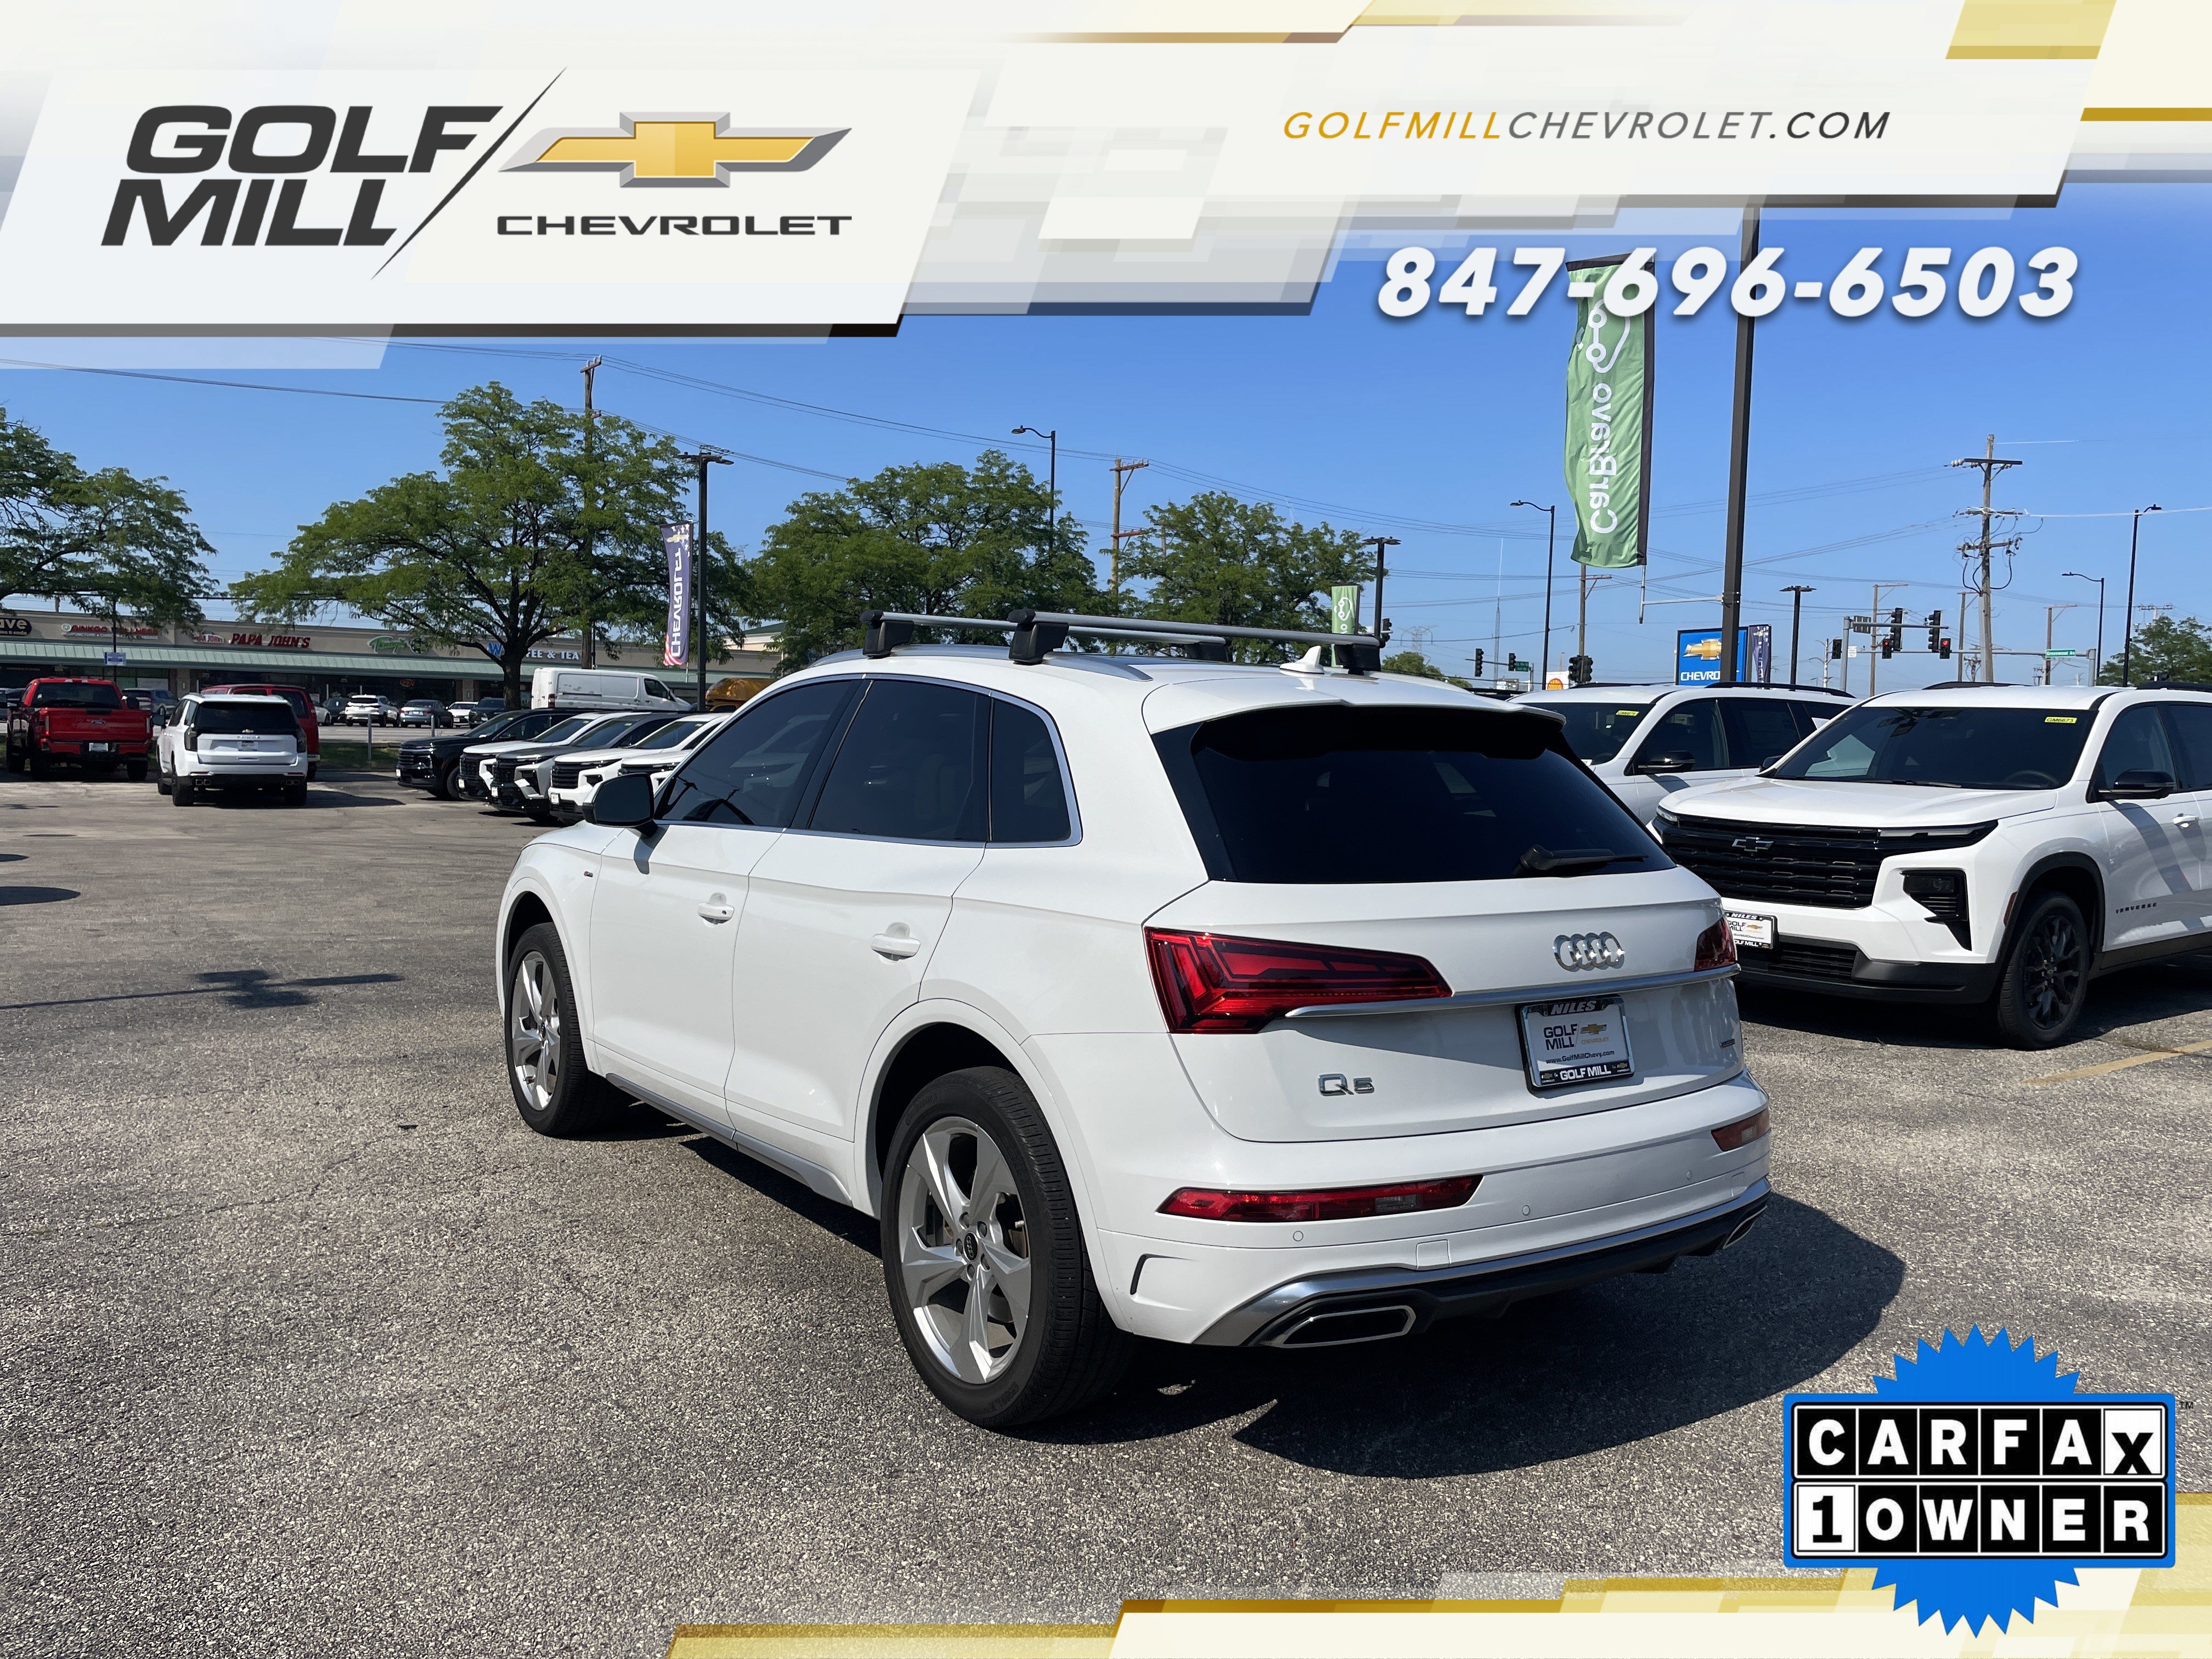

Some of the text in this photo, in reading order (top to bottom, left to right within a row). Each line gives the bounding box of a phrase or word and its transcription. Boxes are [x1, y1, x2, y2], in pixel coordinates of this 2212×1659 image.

[230, 633, 311, 648] PAPA JOHN'S
[560, 651, 579, 659] TEA
[1680, 671, 1720, 681] CHEVRO
[1550, 1001, 1596, 1015] NILES
[1543, 1023, 1578, 1039] GOLF
[1545, 1036, 1575, 1051] MILL
[1545, 1051, 1615, 1064] www.GolfMillChevy.com
[1560, 1065, 1611, 1080] GOLF MILL
